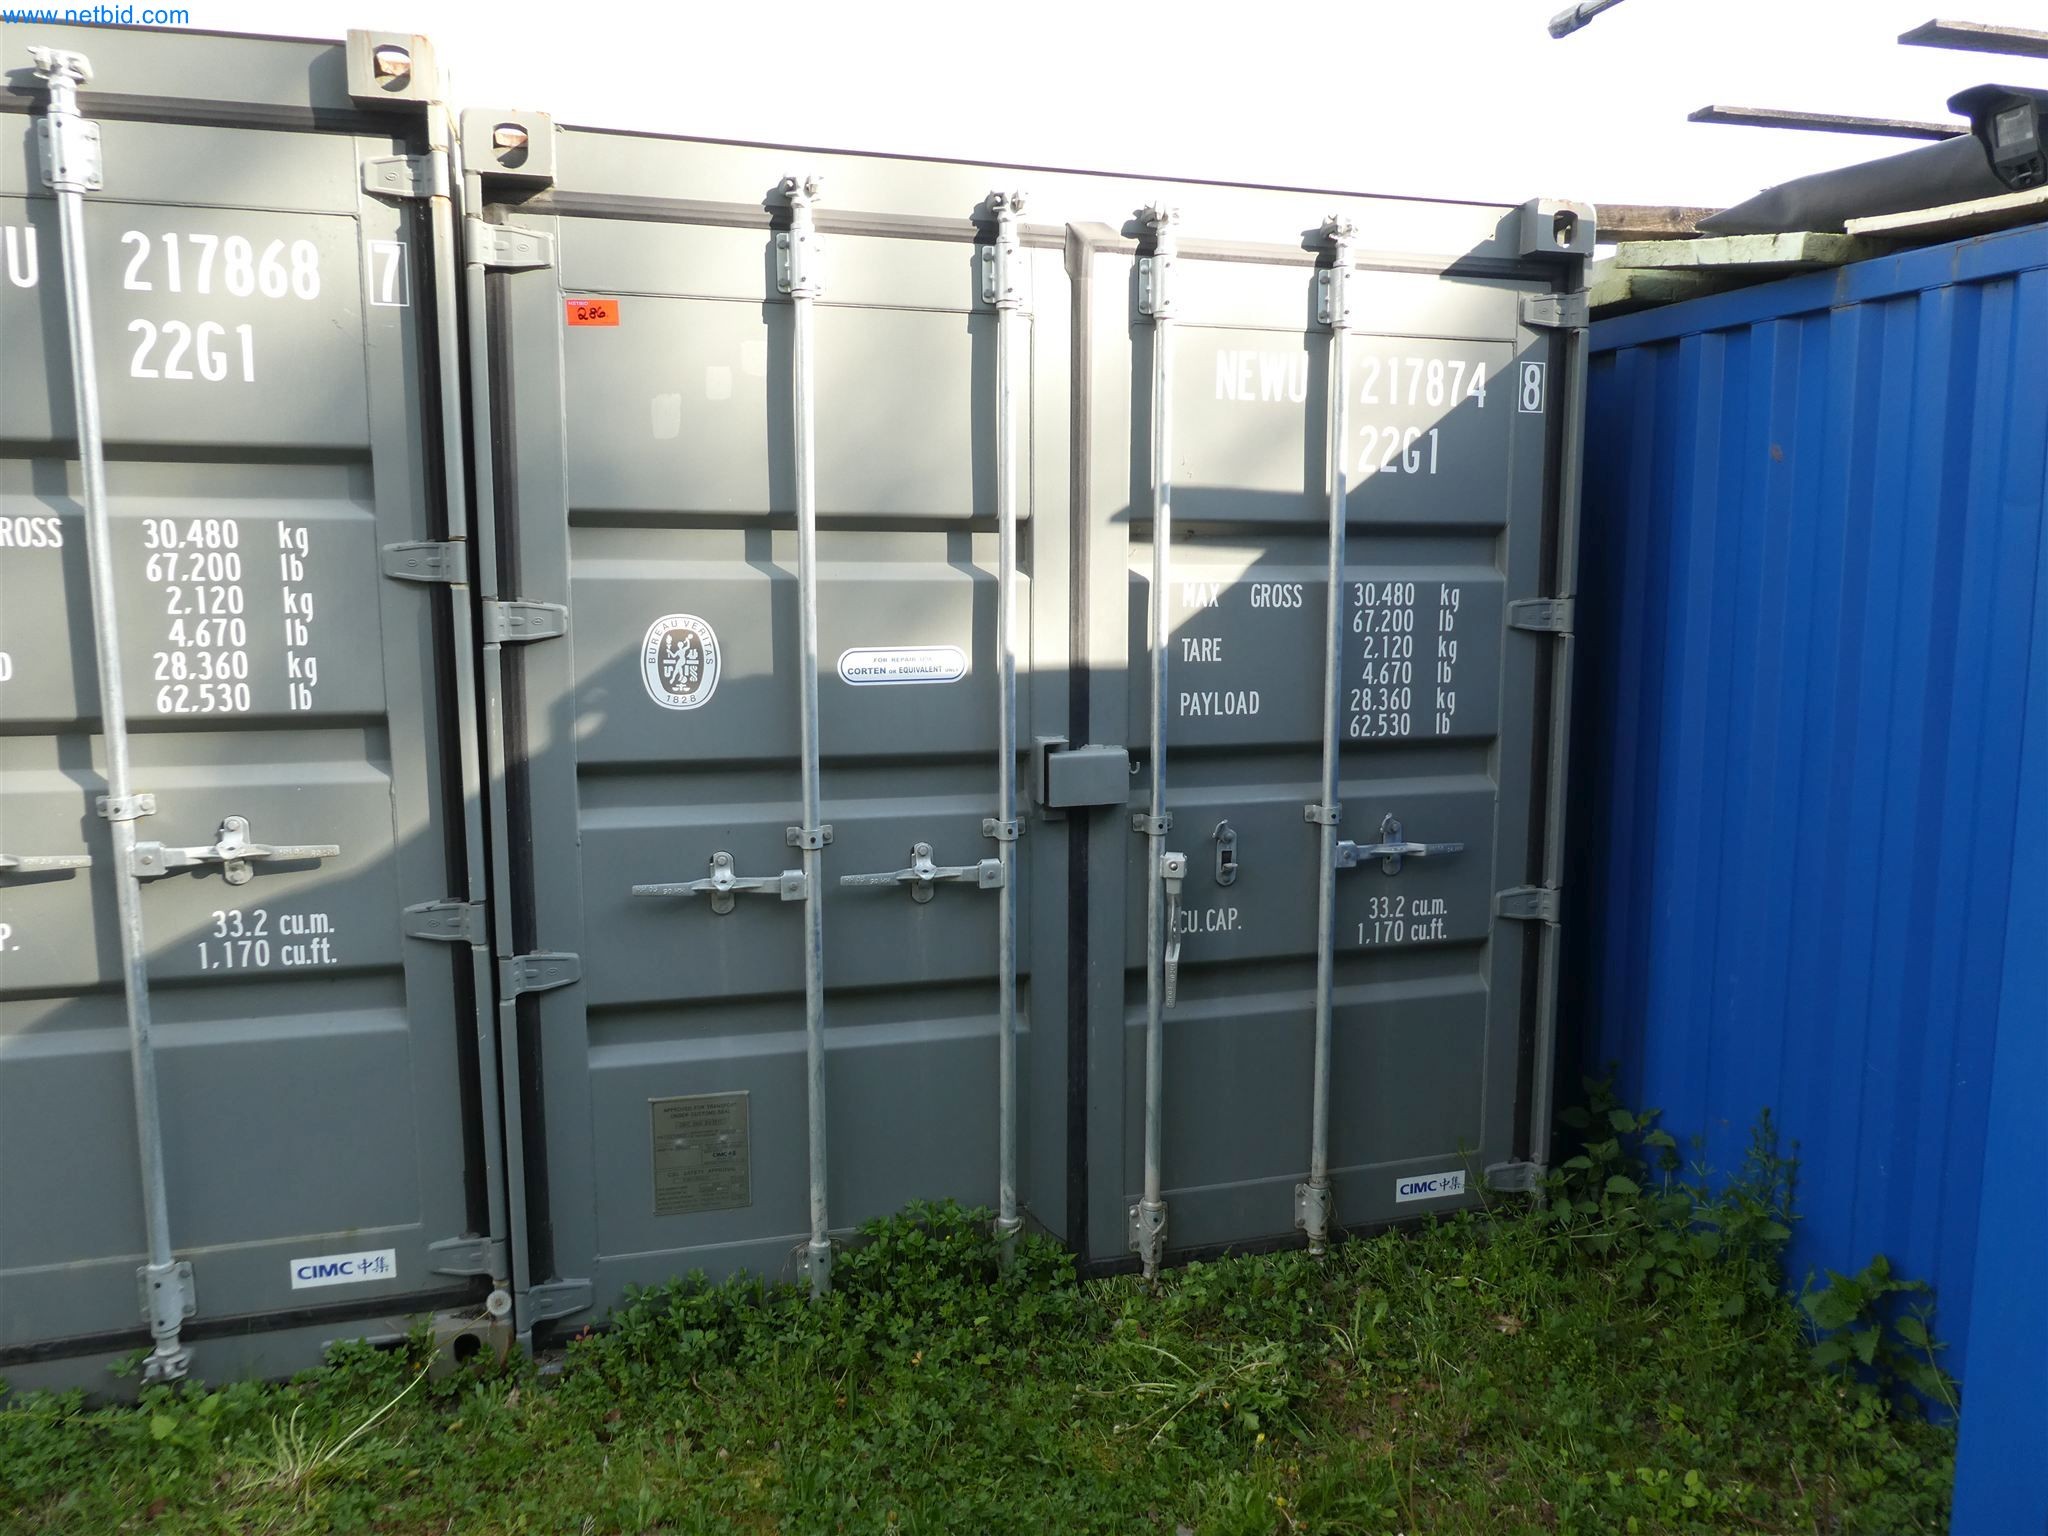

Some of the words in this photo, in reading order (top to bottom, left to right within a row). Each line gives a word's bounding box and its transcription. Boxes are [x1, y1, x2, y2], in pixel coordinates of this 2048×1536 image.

[121, 231, 321, 300] 217868
[374, 244, 402, 303] 7
[577, 306, 606, 320] 286
[128, 319, 255, 382] 22G1
[1215, 350, 1309, 403] NEWU
[1360, 358, 1486, 408] 217874
[1522, 363, 1541, 411] 8
[1358, 425, 1439, 474] 22G1
[142, 518, 239, 549] 30,480
[278, 521, 309, 558] kg
[146, 552, 241, 582] 67,200
[281, 554, 304, 581] lb
[166, 585, 244, 615] 2,120
[283, 586, 313, 623] kg
[1182, 583, 1219, 608] MAX
[1251, 583, 1303, 608] GROSS
[1354, 583, 1415, 606] 30,480
[1440, 584, 1460, 612] kg
[168, 618, 246, 647] 4,670
[285, 619, 309, 647] lb
[1353, 609, 1414, 633] 67,200
[1439, 611, 1454, 632] lb
[648, 620, 677, 664] BUREAU
[683, 620, 714, 665] VERITAS
[1182, 638, 1222, 662] TARE
[1363, 636, 1413, 659] 2,120
[1438, 637, 1457, 664] kg
[153, 651, 248, 681] 28,360
[287, 651, 317, 687] kg
[847, 667, 886, 675] CORTEN
[899, 665, 942, 674] EQUIVALENT
[1362, 662, 1412, 685] 4,670
[1437, 662, 1451, 683] lb
[157, 683, 250, 713] 62,530
[290, 683, 312, 710] lb
[666, 694, 697, 704] 1828
[1180, 691, 1260, 716] PAYLOAD
[1351, 687, 1411, 711] 28,360
[1436, 688, 1456, 715] kg
[1350, 713, 1410, 737] 62,530
[1435, 713, 1450, 734] lb
[1369, 896, 1405, 919] 33.2
[1412, 897, 1447, 916] cu.m.
[212, 910, 268, 939] 33.2
[280, 910, 335, 936] cu.m.
[1358, 920, 1404, 944] 1,170
[1410, 918, 1447, 941] cu.ft.
[198, 939, 270, 969] 1,170
[281, 938, 337, 967] cu.ft.
[1399, 1180, 1437, 1196] CIMC
[297, 1261, 354, 1280] CIMC
